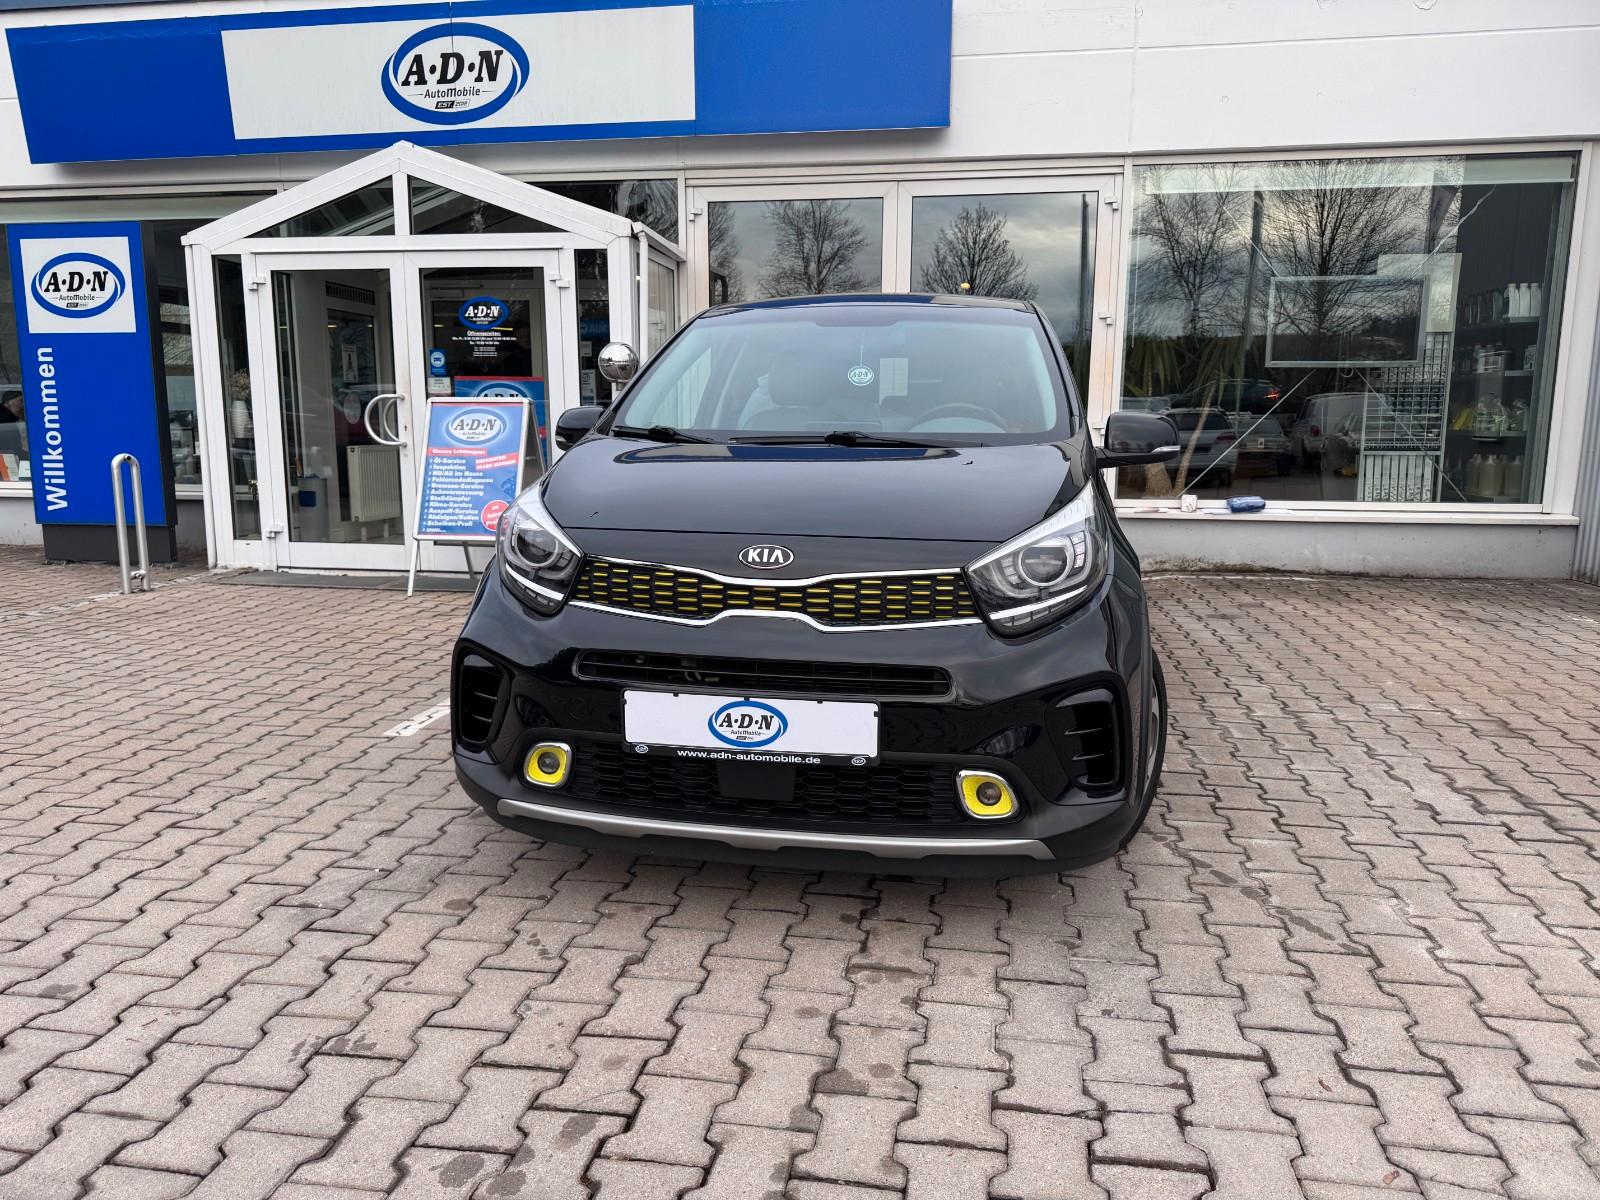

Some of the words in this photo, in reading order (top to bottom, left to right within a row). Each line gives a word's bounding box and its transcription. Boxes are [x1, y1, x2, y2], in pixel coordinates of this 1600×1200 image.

[424, 86, 481, 99] AutoMobile
[37, 347, 68, 511] Willkommen
[747, 548, 784, 563] KIA
[677, 750, 821, 764] www.adn-automobile.de
